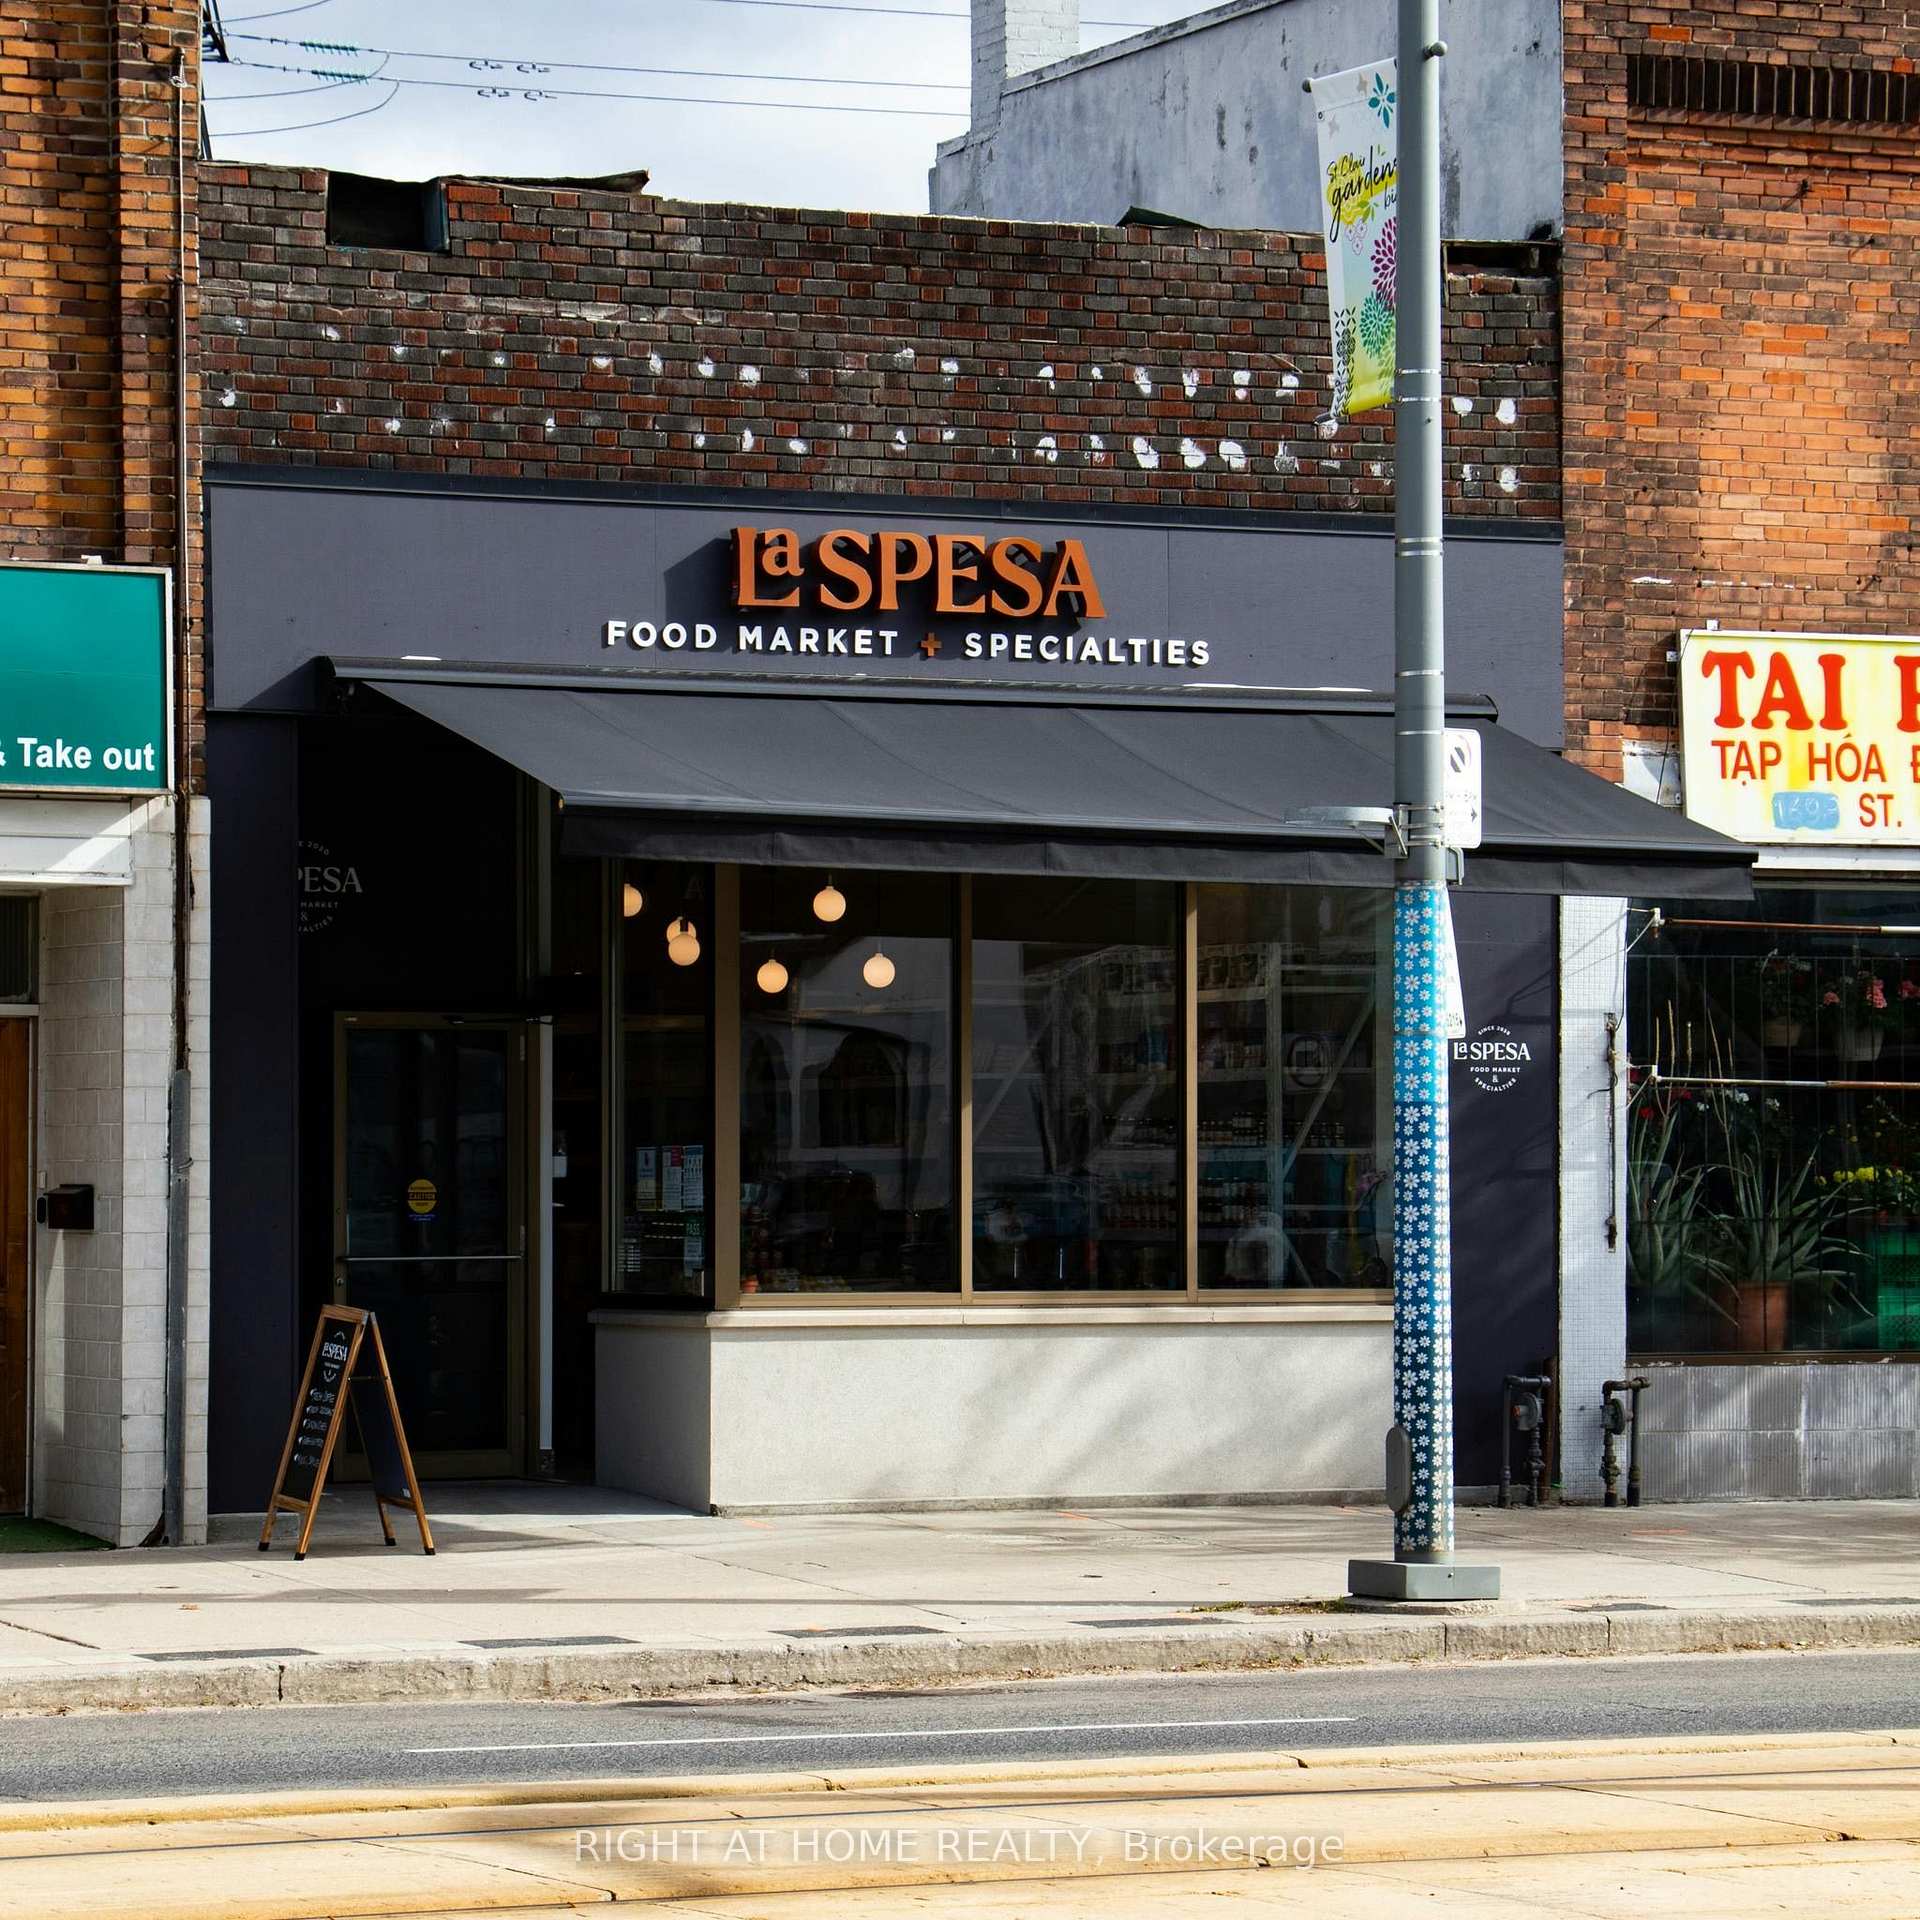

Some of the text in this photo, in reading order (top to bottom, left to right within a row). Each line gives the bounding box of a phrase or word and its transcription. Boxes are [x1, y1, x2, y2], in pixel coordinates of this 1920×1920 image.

[733, 526, 1107, 619] La SPESA
[606, 620, 718, 649] FOOD
[738, 625, 899, 655] MARKET
[964, 632, 1211, 666] SPECIALTIES
[1701, 649, 1849, 731] TAI
[16, 737, 92, 770] Take
[102, 742, 156, 772] out
[1711, 739, 1782, 787] TẠP
[1807, 733, 1888, 783] HÓA
[1858, 792, 1902, 828] ST.
[1453, 1042, 1532, 1061] La SPESA
[1475, 1077, 1517, 1092] SPECIALTIES
